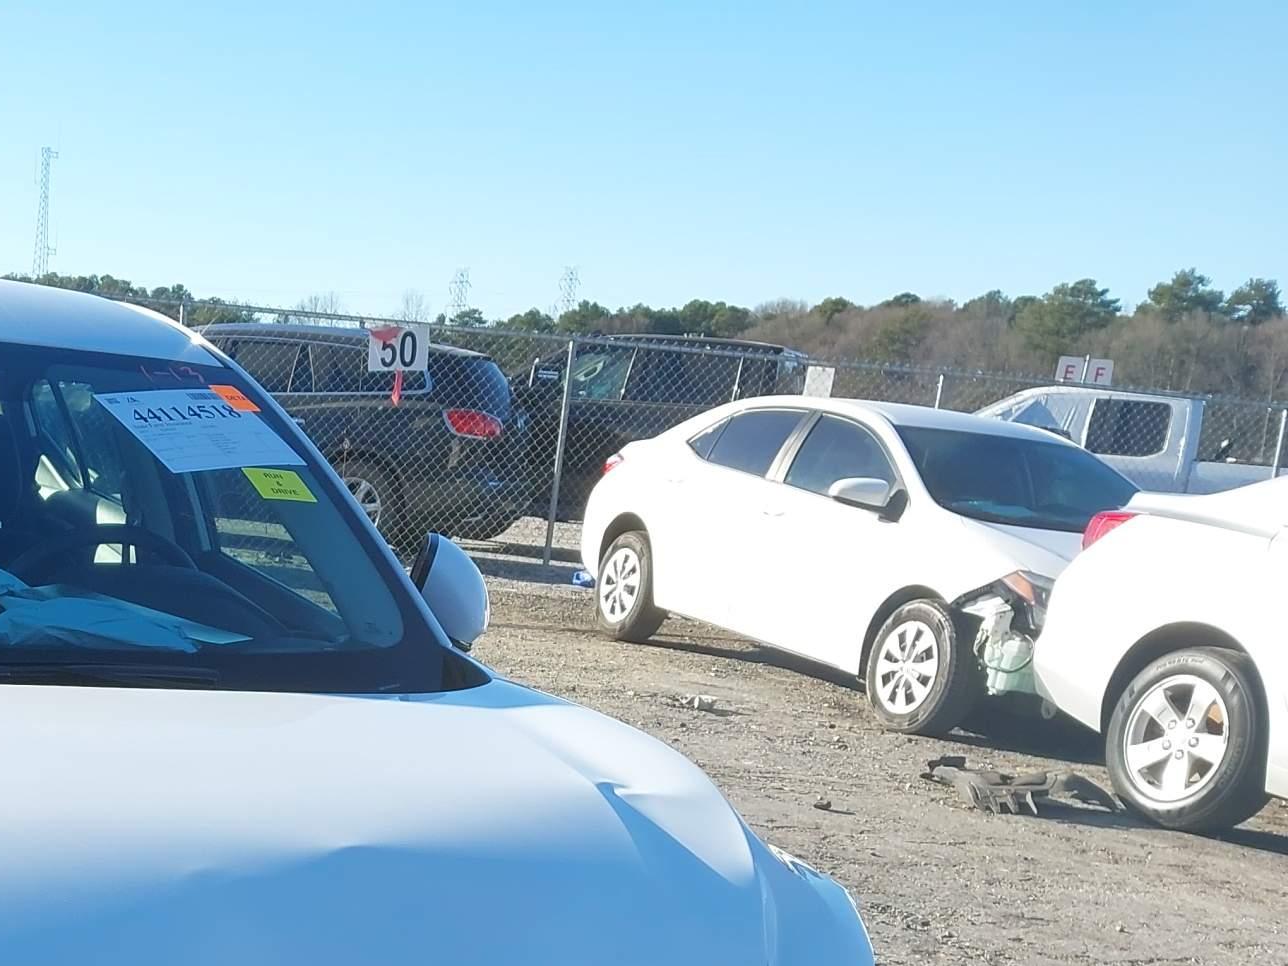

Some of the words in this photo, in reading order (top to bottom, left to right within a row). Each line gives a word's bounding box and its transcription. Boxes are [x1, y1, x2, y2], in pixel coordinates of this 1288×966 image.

[380, 330, 417, 367] 50
[1064, 364, 1076, 380] E
[1094, 366, 1106, 382] F
[133, 404, 241, 423] 44114518
[263, 472, 283, 480] RUN
[270, 487, 300, 496] DRIVE
